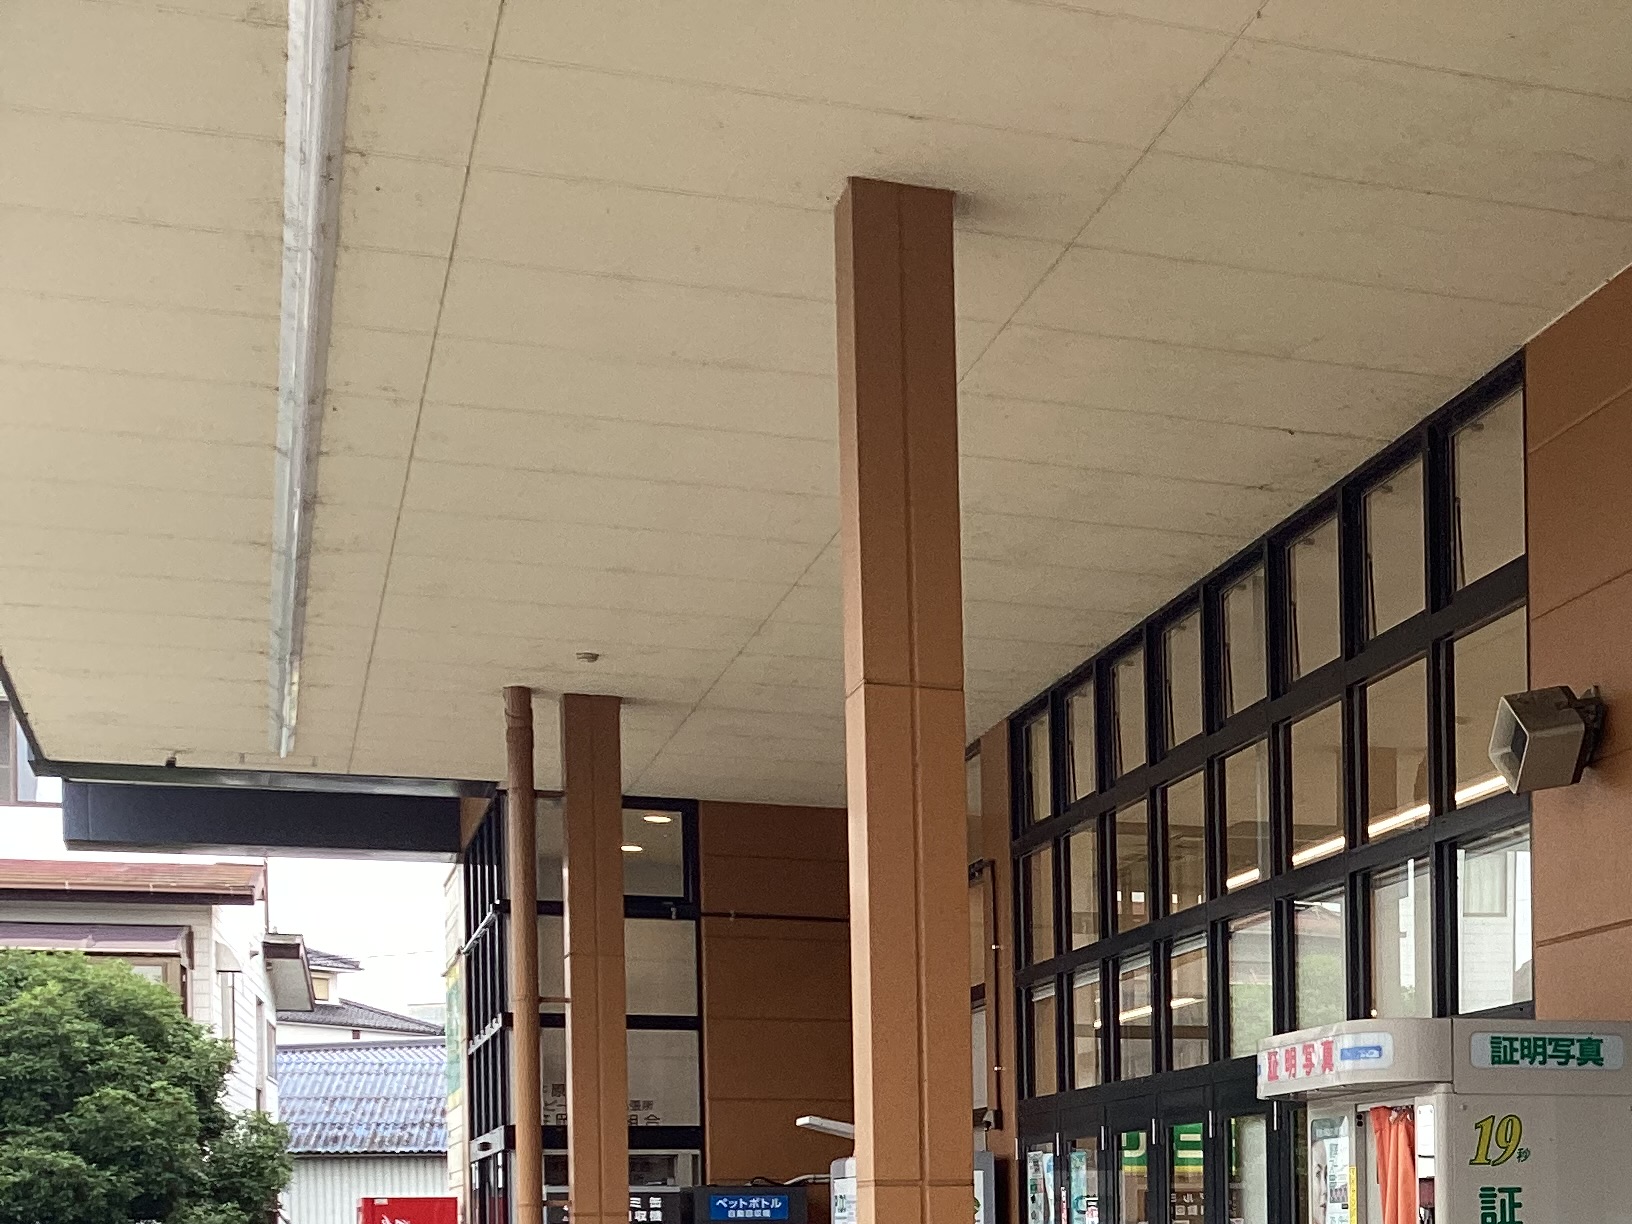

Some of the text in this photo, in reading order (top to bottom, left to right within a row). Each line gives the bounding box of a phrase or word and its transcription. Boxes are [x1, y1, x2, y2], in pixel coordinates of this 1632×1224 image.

[1268, 1039, 1334, 1081] 証明写真
[1491, 1036, 1603, 1066] 証明写真
[715, 1197, 782, 1208] ペットボトル
